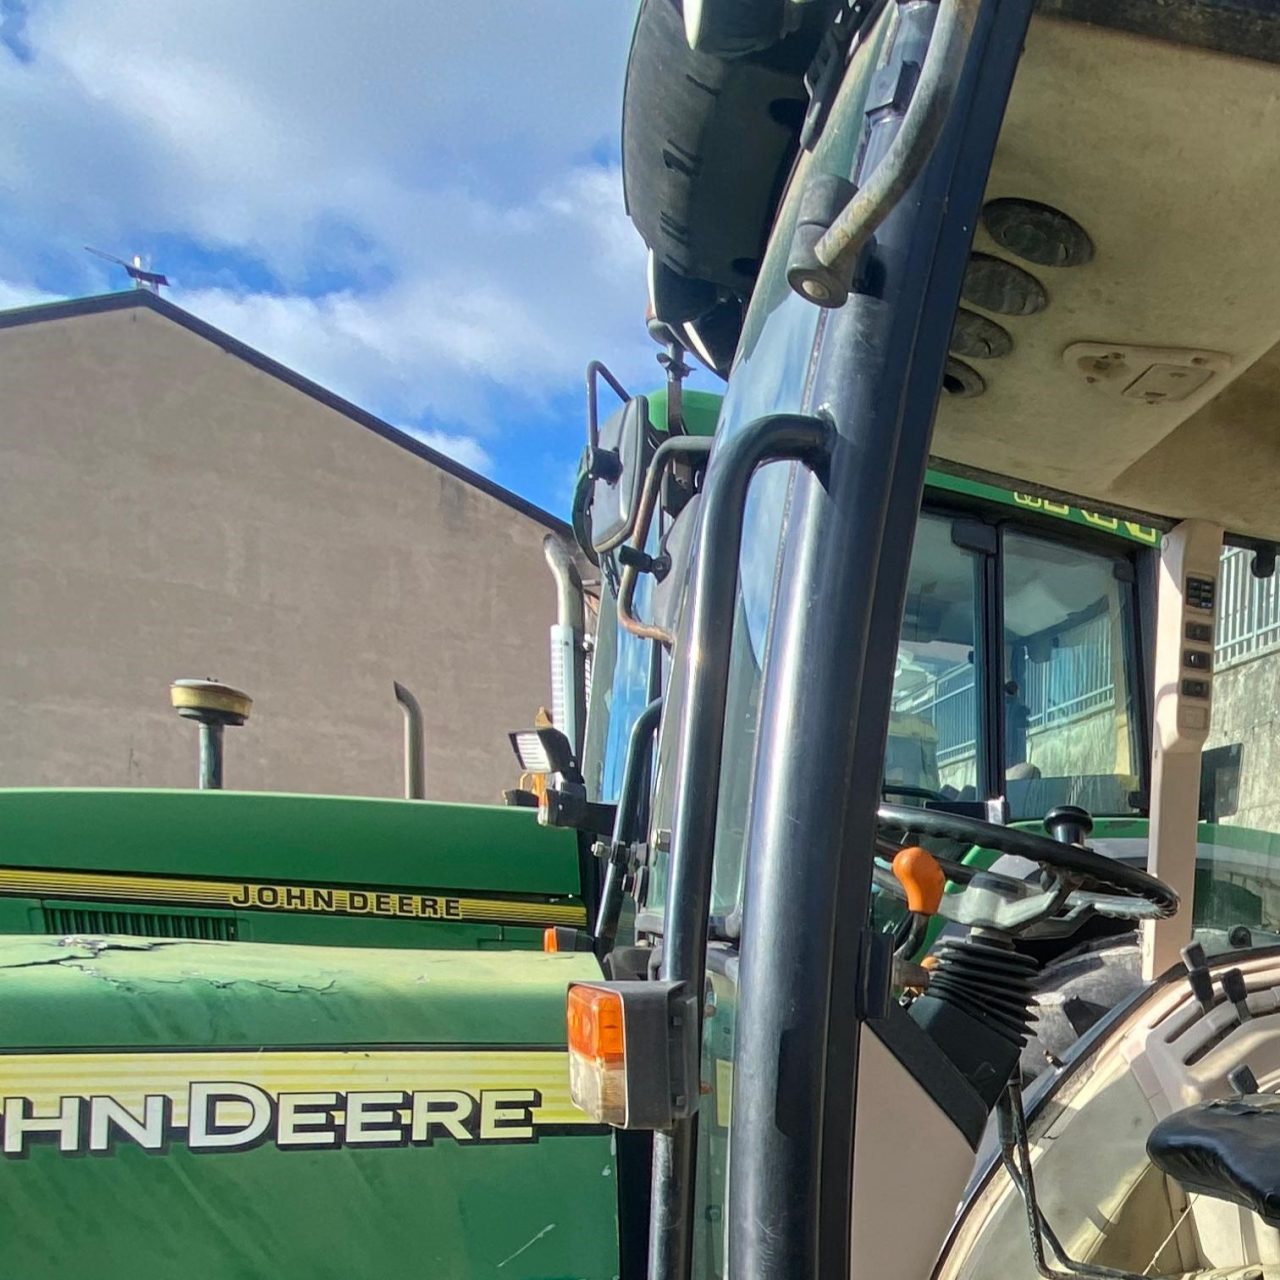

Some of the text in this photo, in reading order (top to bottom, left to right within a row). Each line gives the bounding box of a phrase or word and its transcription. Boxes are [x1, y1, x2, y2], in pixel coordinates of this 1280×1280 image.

[232, 885, 462, 919] JOHN DEERE
[188, 1081, 539, 1152] DEERE
